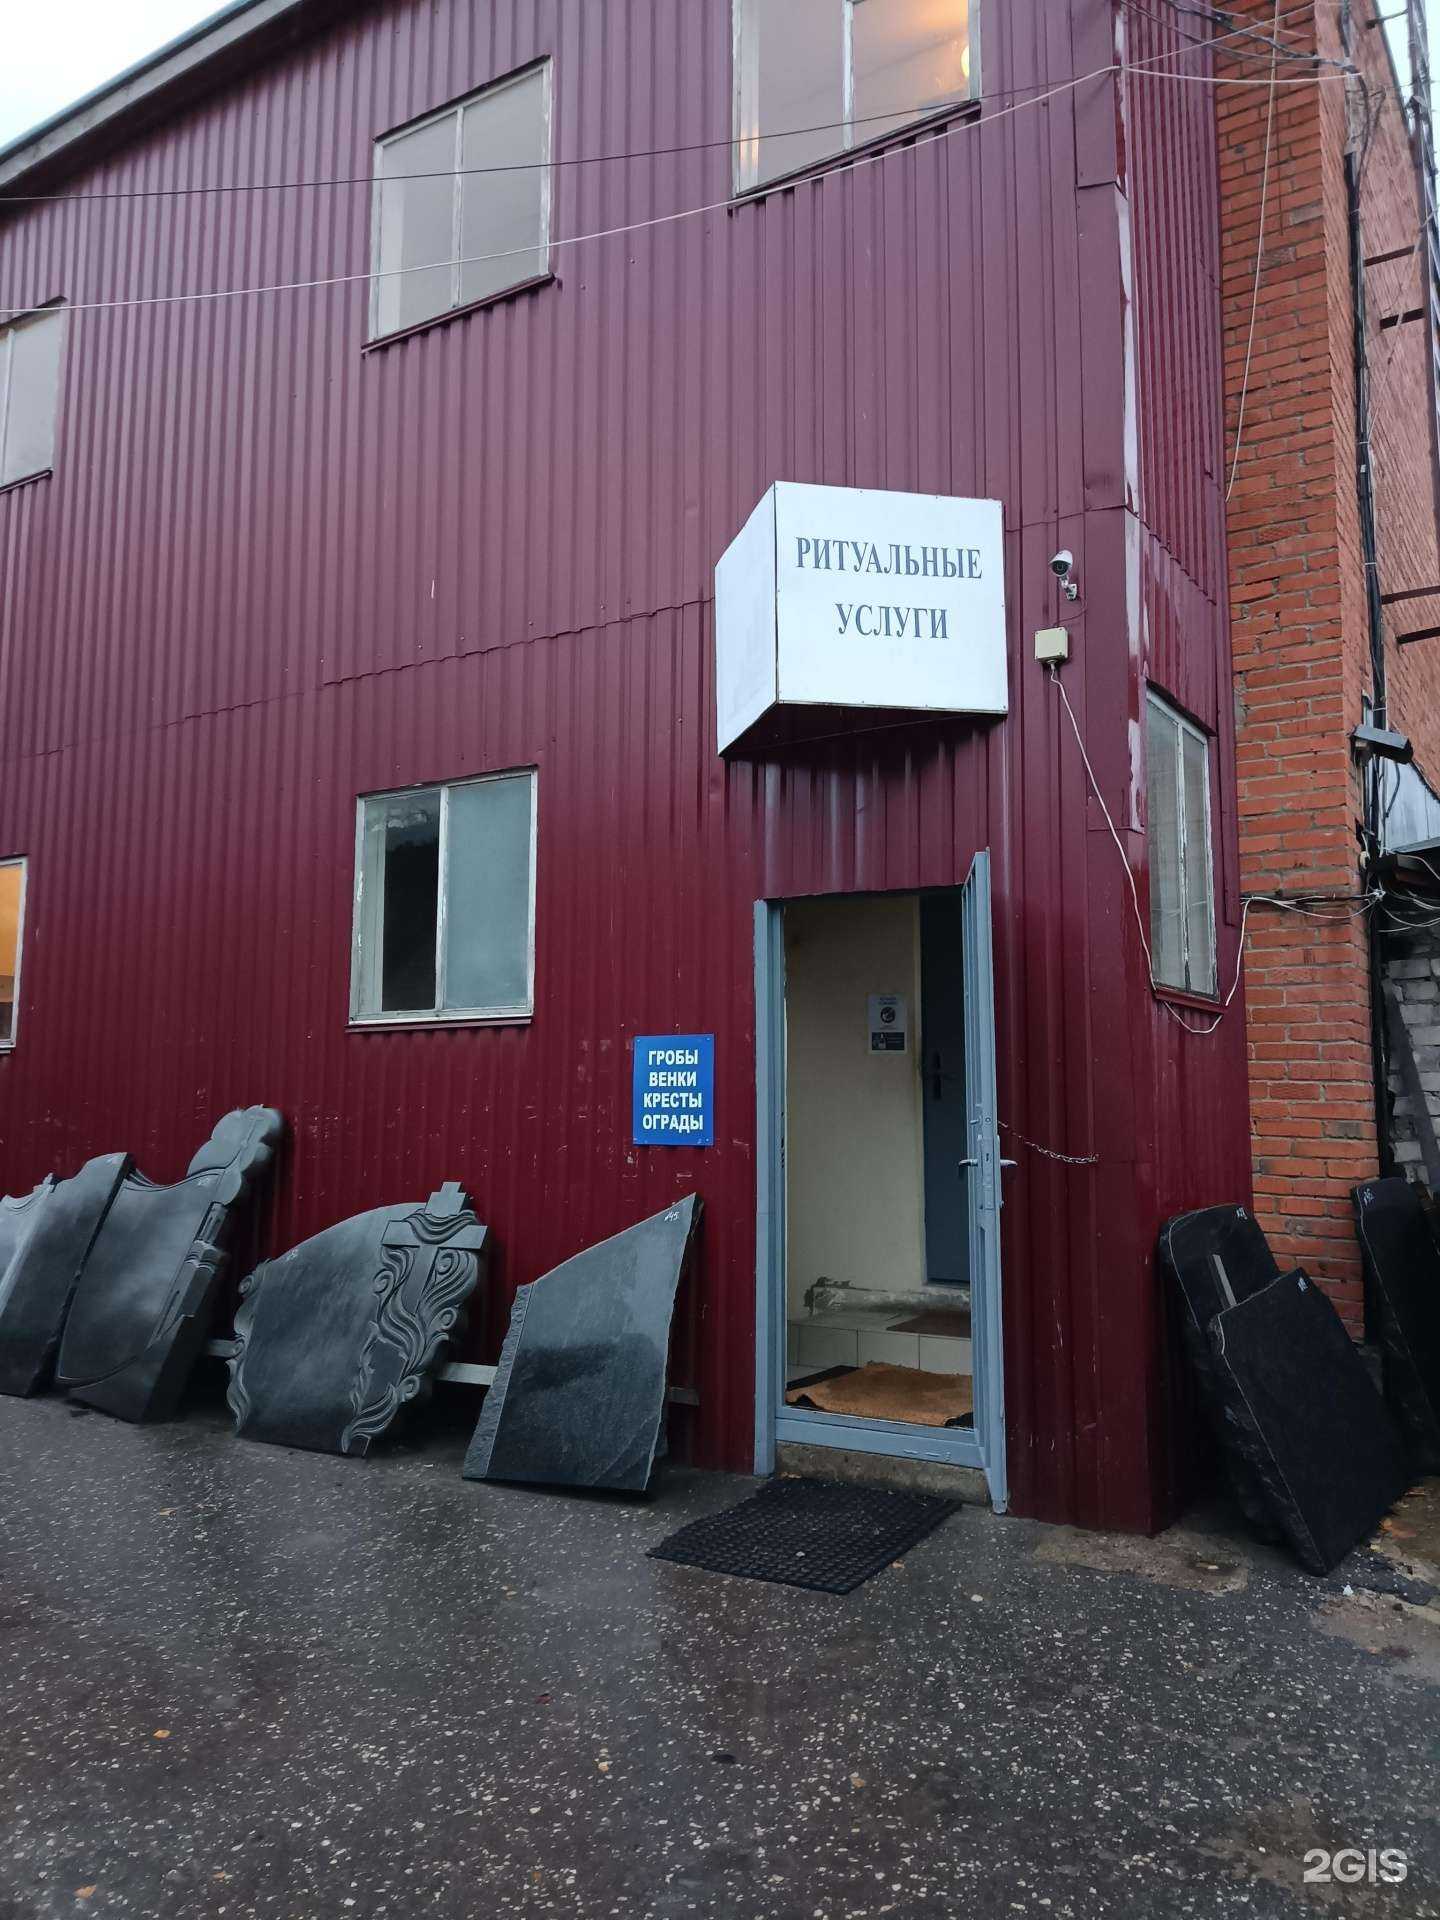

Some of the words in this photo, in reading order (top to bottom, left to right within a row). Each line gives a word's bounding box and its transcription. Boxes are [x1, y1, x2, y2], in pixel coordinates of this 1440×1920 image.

[795, 536, 983, 580] РИТУАЛЬНЫЕ
[834, 603, 950, 639] УСЛУГИ
[648, 1049, 699, 1066] ГРОБЫ
[649, 1071, 697, 1087] ВЕНКИ
[643, 1092, 702, 1108] КРЕСТЫ
[642, 1114, 703, 1134] ОГРАДЫ
